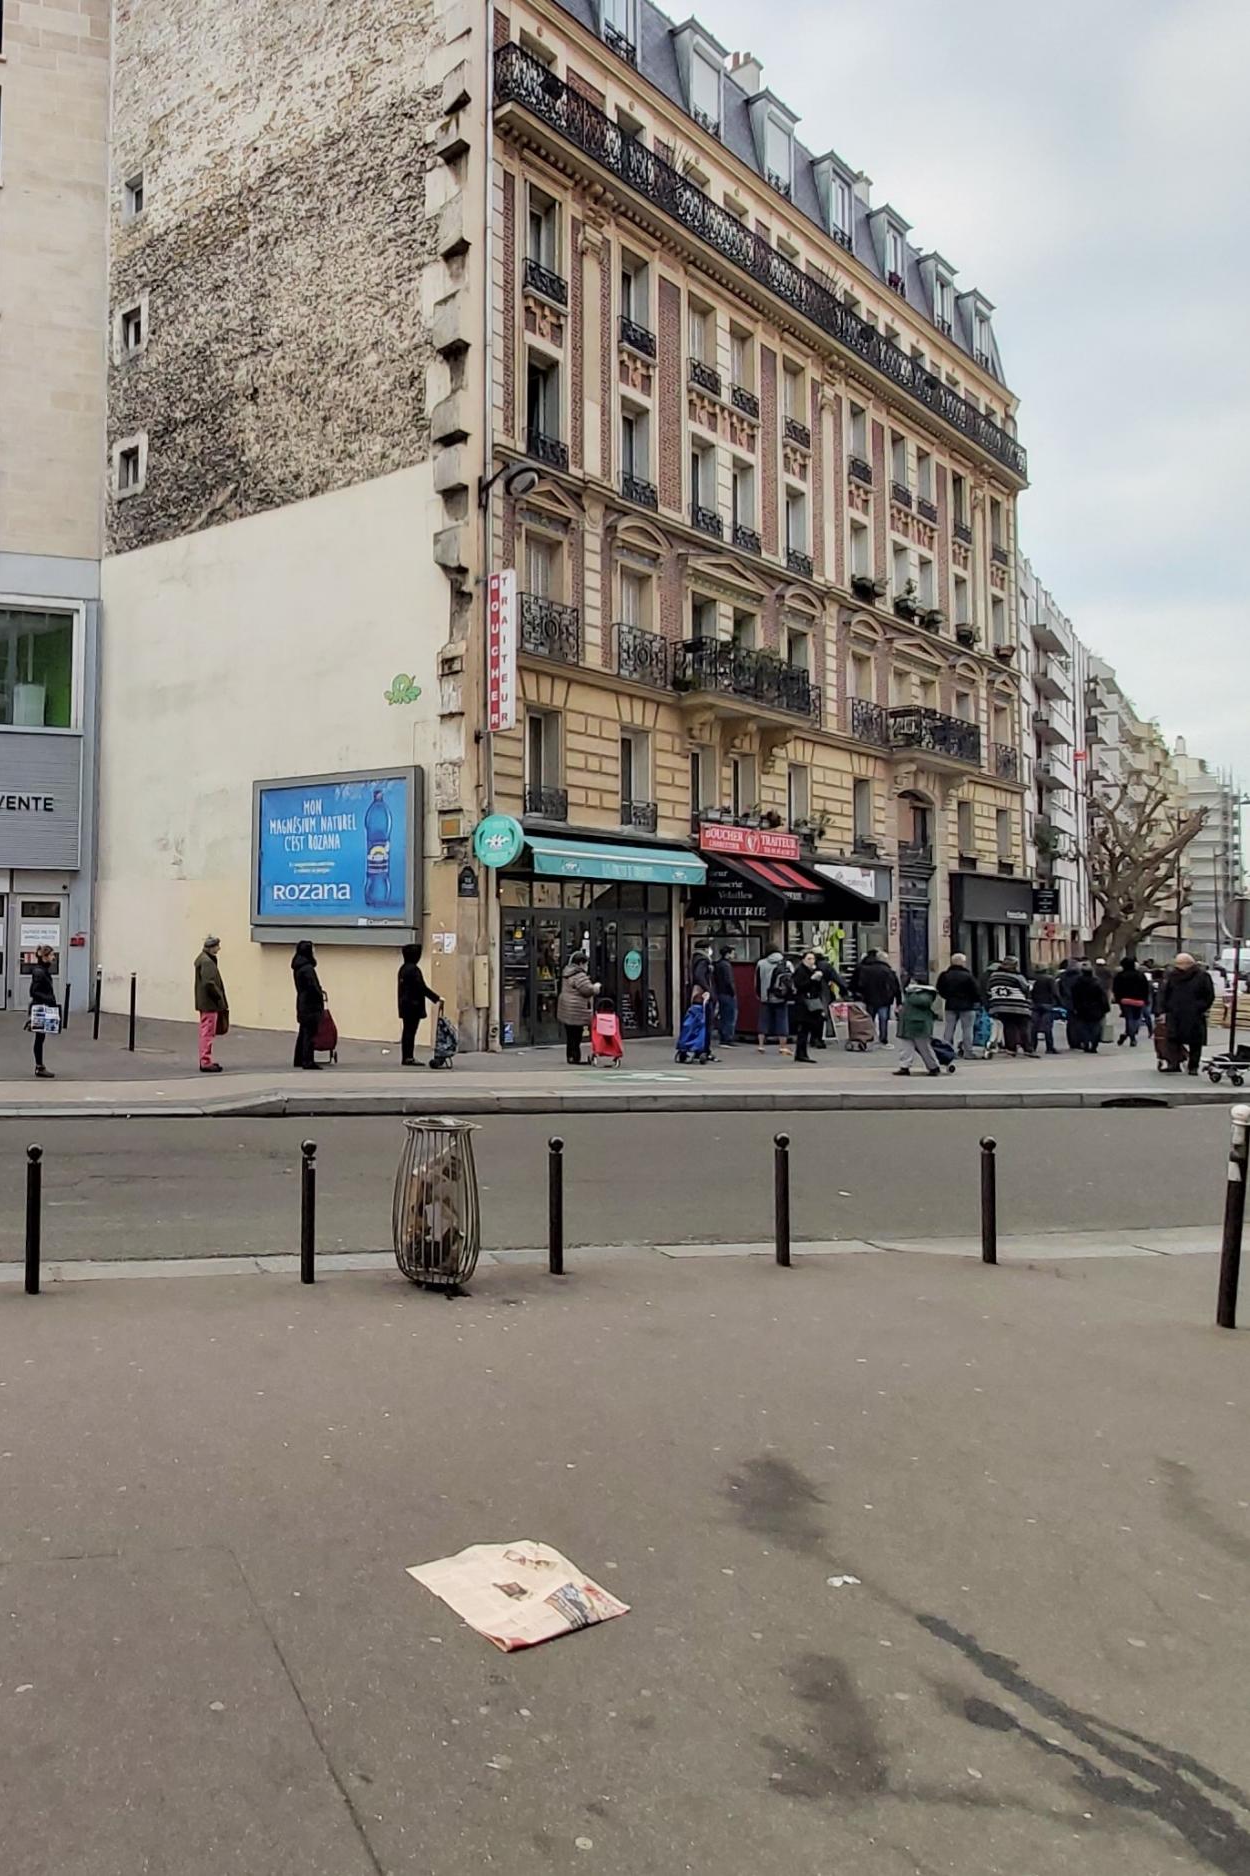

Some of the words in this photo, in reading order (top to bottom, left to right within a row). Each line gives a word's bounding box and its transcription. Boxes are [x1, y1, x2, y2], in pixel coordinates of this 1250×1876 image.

[491, 579, 499, 723] BOUCHER
[303, 799, 322, 815] MON
[269, 815, 316, 835] MAGNÉSIUM
[320, 814, 358, 833] NATUREL
[284, 835, 305, 852] C'EST
[308, 833, 341, 850] ROZANA
[705, 828, 743, 842] BOUCHER
[760, 834, 797, 849] TRAITEUR
[699, 906, 767, 917] BOUCHERIE
